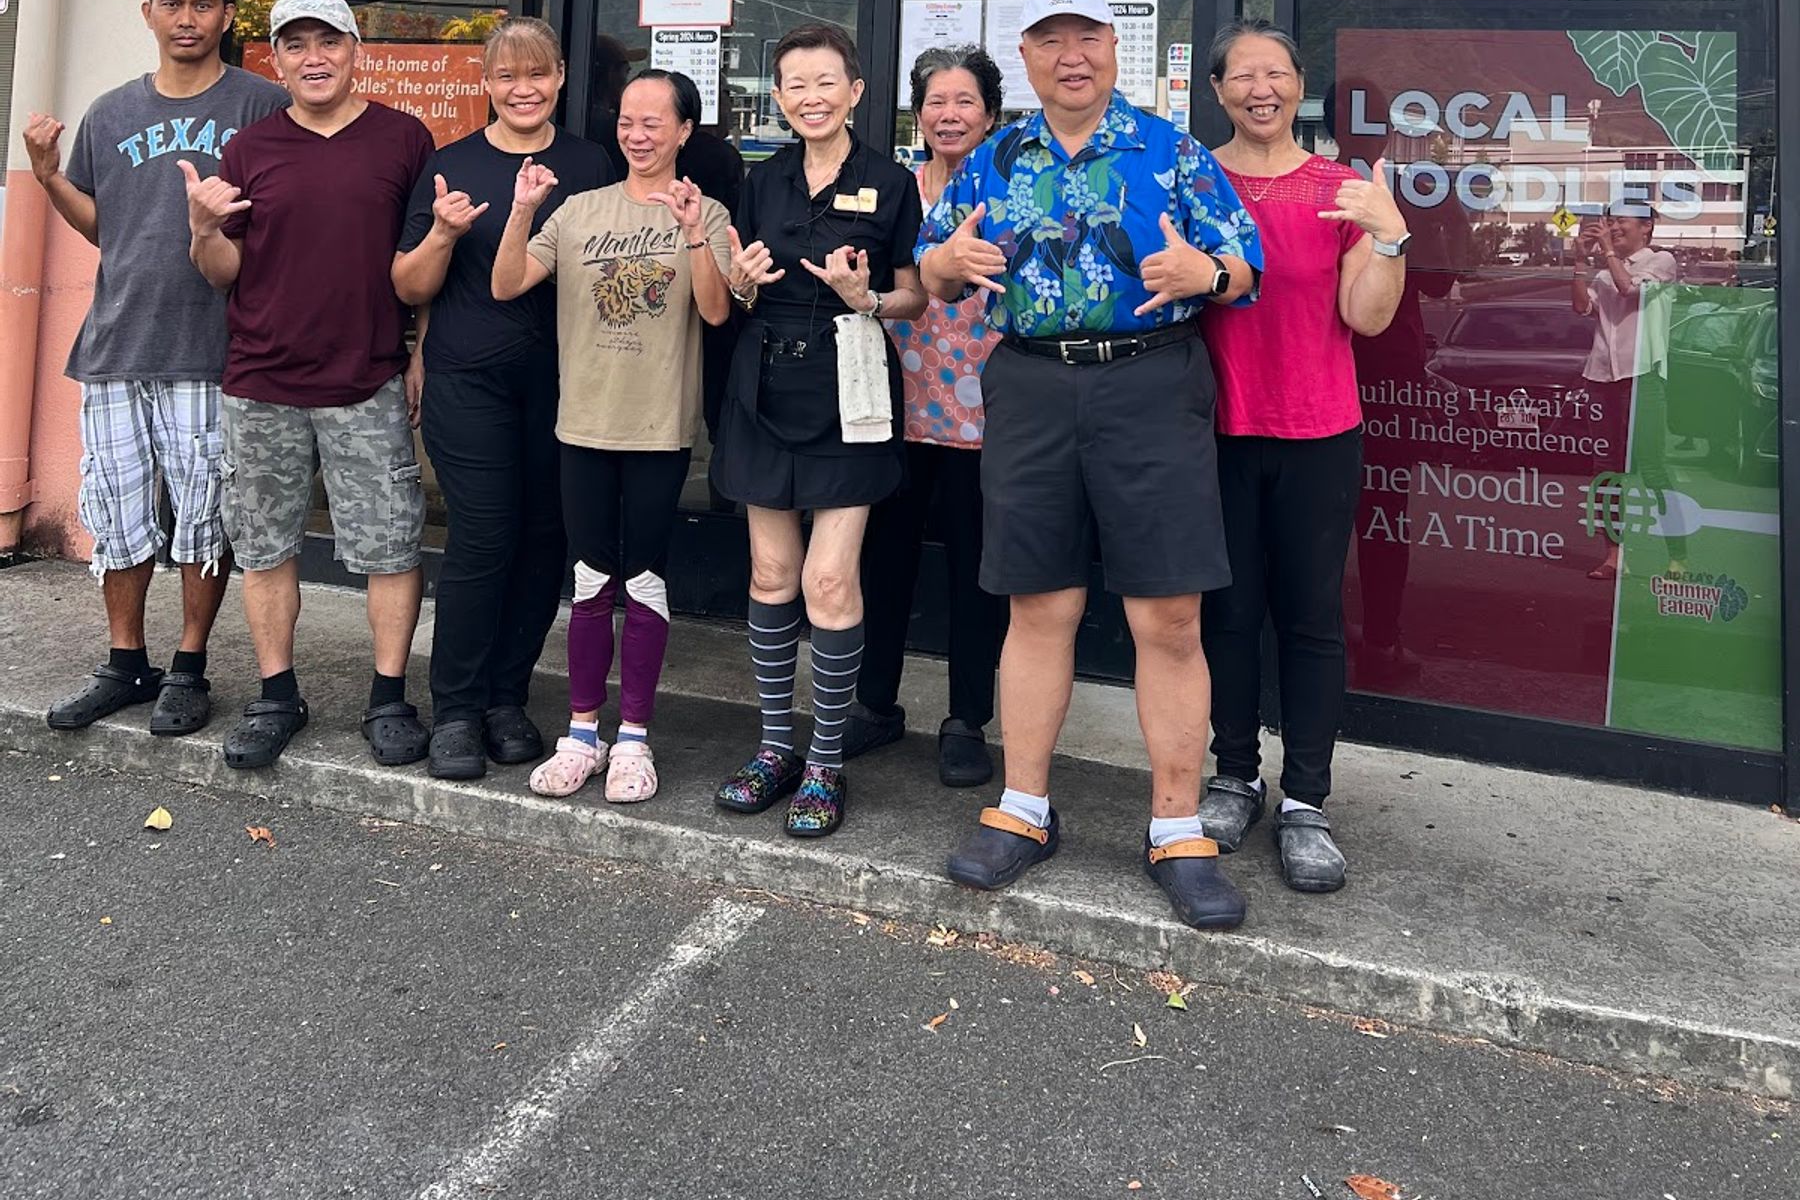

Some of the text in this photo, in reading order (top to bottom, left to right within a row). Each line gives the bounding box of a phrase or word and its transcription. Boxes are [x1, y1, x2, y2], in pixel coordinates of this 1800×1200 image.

[1128, 4, 1149, 14] Hours
[659, 32, 679, 43] Spring
[695, 31, 714, 41] Hours
[360, 55, 449, 72] the home of
[397, 78, 421, 94] the
[425, 79, 485, 99] original
[431, 101, 457, 118] Ulu
[1351, 90, 1588, 143] LOCAL
[1360, 380, 1459, 416] uilding
[1410, 417, 1609, 455] Independence
[1363, 461, 1564, 508] ne Noodle
[1362, 506, 1564, 559] At A Time
